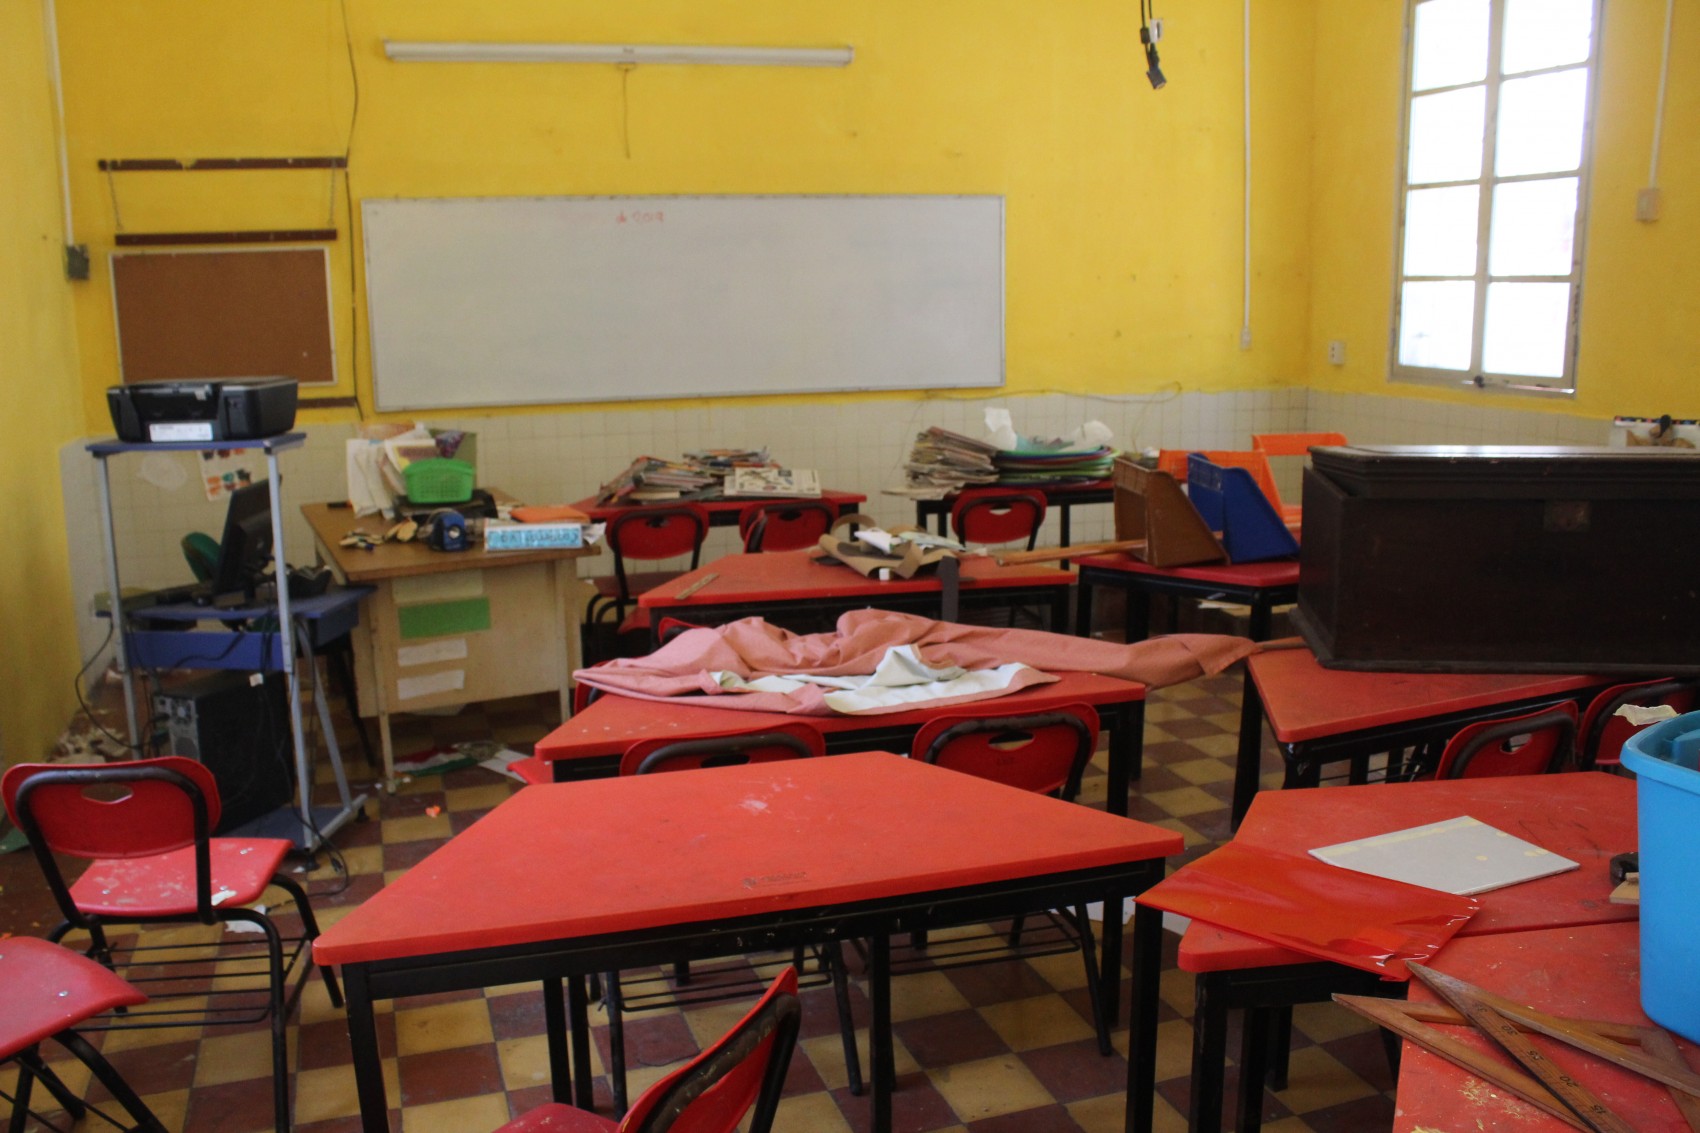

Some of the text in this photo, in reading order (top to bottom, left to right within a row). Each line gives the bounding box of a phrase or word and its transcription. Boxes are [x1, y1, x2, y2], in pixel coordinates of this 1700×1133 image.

[1501, 1025, 1518, 1036] 30
[1527, 1050, 1545, 1062] 25
[1560, 1075, 1579, 1088] 20
